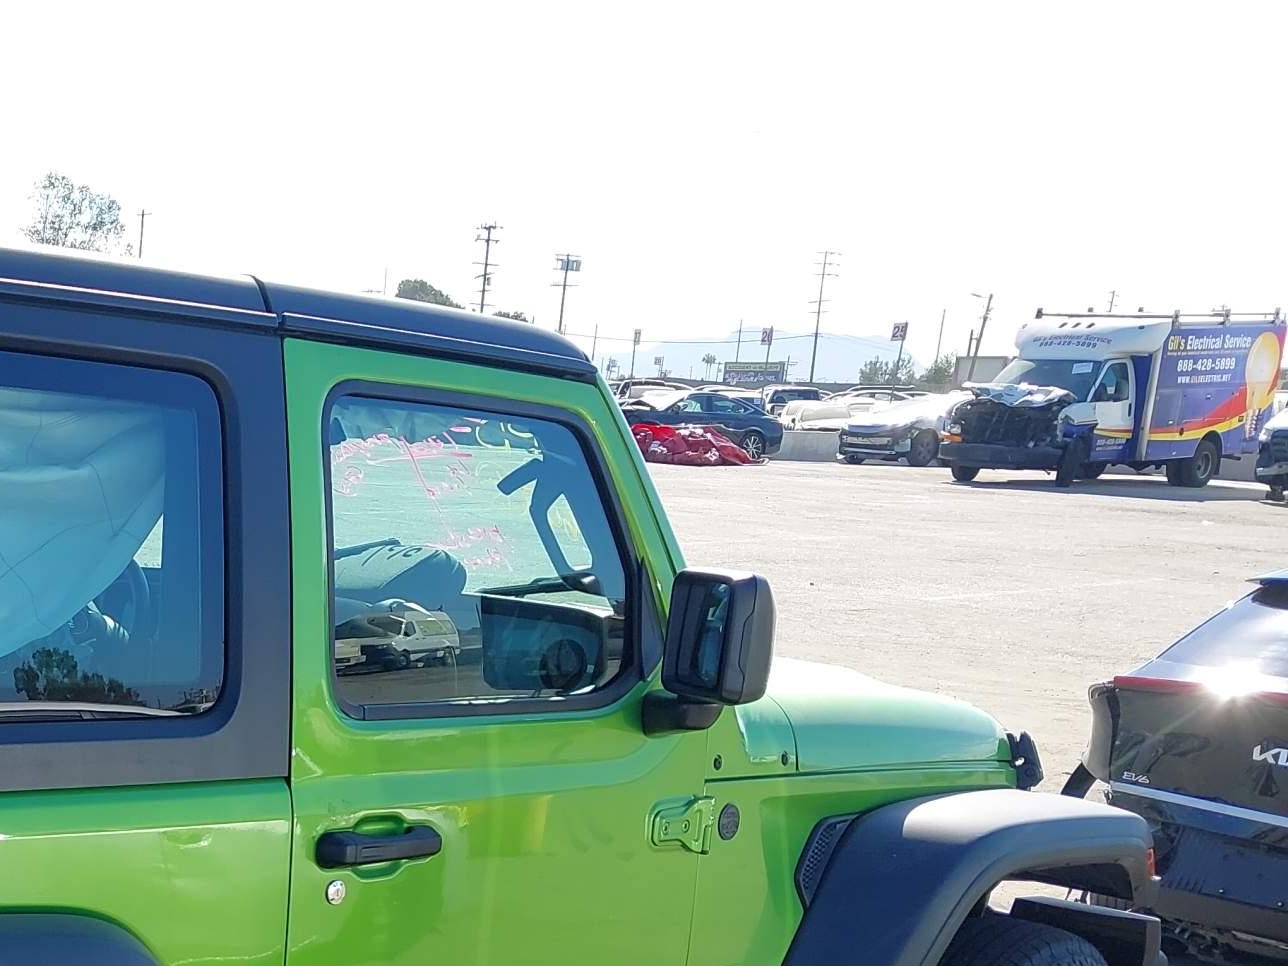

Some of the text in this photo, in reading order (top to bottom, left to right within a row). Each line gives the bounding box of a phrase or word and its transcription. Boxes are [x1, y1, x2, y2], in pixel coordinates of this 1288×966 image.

[1168, 334, 1252, 350] Gil's Electrical Service
[1177, 357, 1236, 372] 888-428-5899
[1122, 771, 1150, 784] EV6
